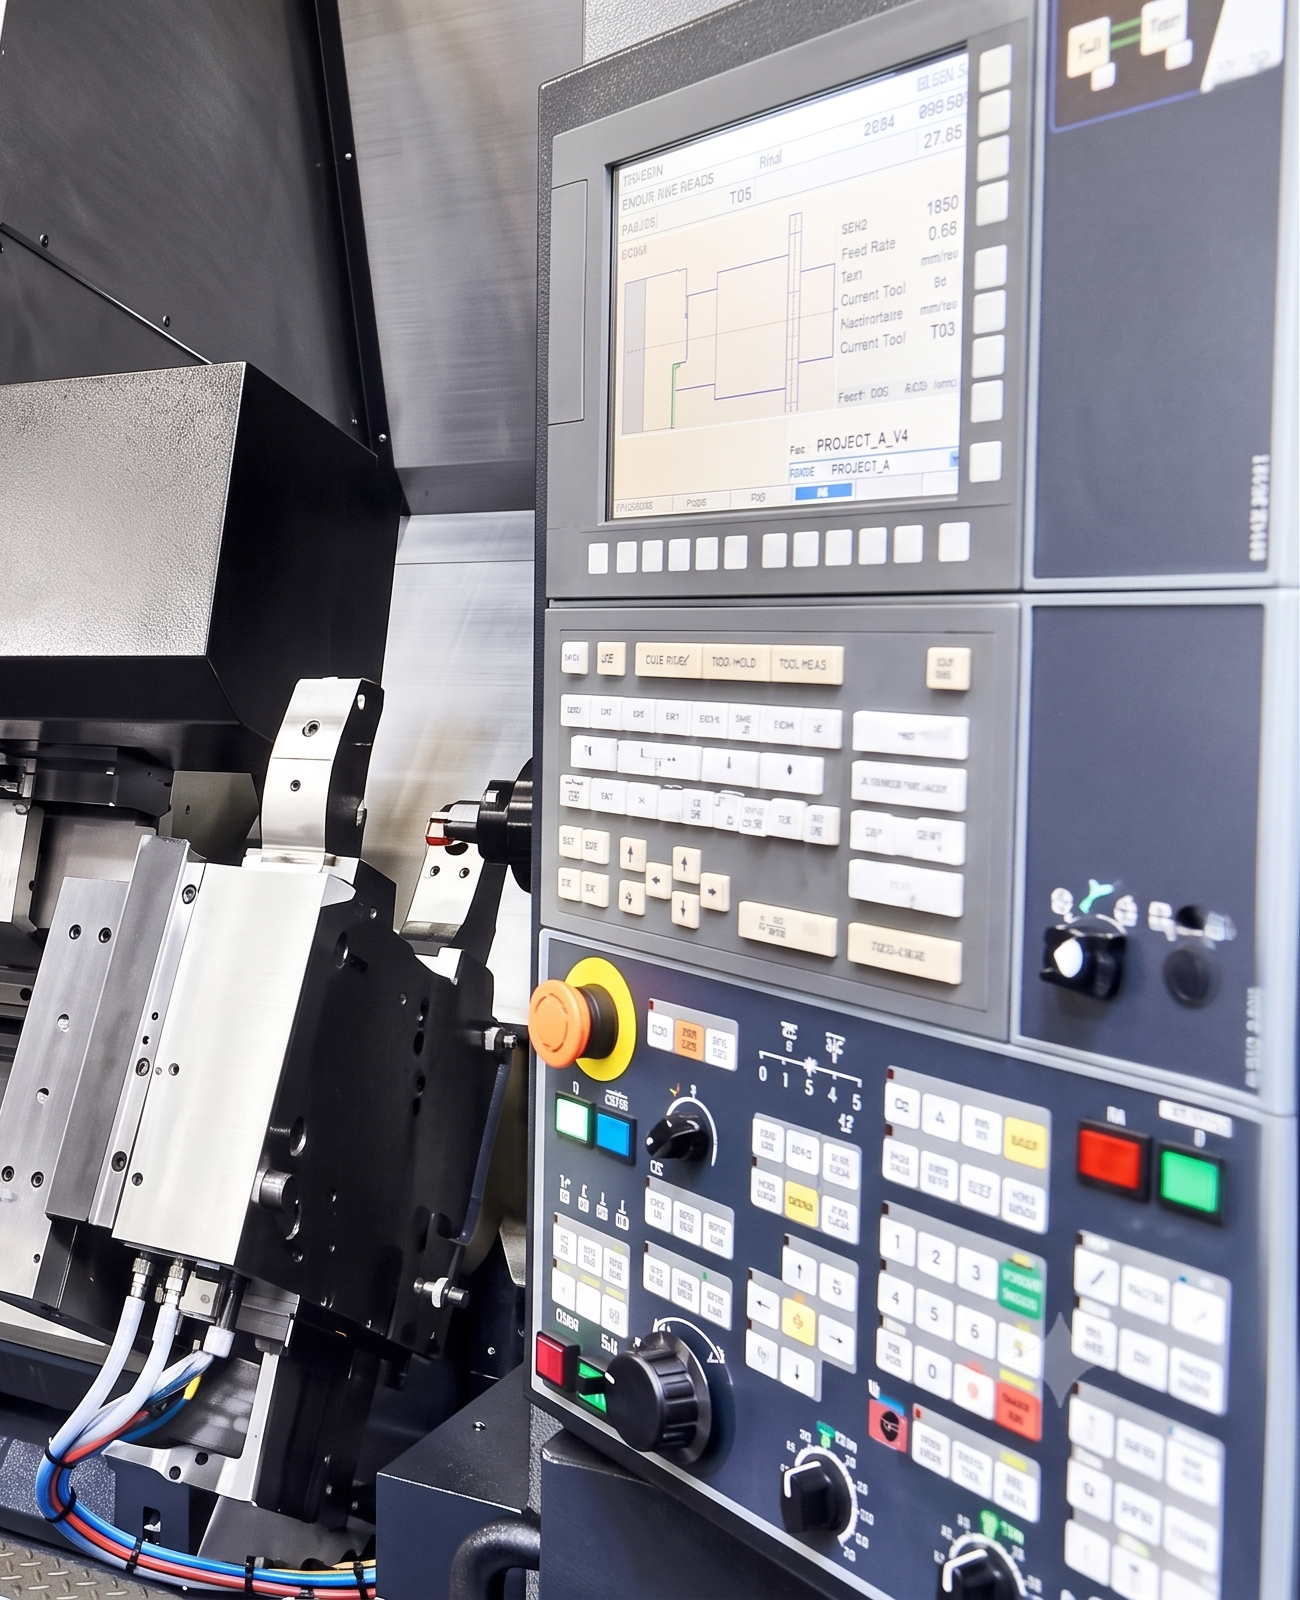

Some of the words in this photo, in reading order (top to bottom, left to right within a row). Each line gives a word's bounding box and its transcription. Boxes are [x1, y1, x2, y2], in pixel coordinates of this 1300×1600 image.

[923, 124, 962, 149] 27.85
[729, 186, 752, 205] T05
[927, 194, 959, 216] 1850
[842, 243, 867, 261] Feed
[871, 239, 896, 254] Rate
[928, 220, 957, 241] 0.68
[840, 289, 879, 306] Current
[883, 281, 906, 298] Tool
[840, 337, 879, 354] Current
[883, 331, 906, 347] Tool
[930, 321, 955, 340] T03
[816, 429, 909, 453] PROJECT_A_V4
[831, 460, 890, 475] PROJECT_A
[758, 1065, 768, 1082] 0
[782, 1072, 788, 1088] 1
[804, 1079, 814, 1096] 5
[827, 1086, 838, 1104] 4
[852, 1093, 862, 1111] 5
[894, 1234, 900, 1249] 1
[932, 1250, 941, 1266] 2
[972, 1265, 981, 1281] 3
[892, 1291, 899, 1305] 4
[930, 1306, 938, 1322] 5
[970, 1323, 979, 1339] 6
[928, 1364, 937, 1379] 0
